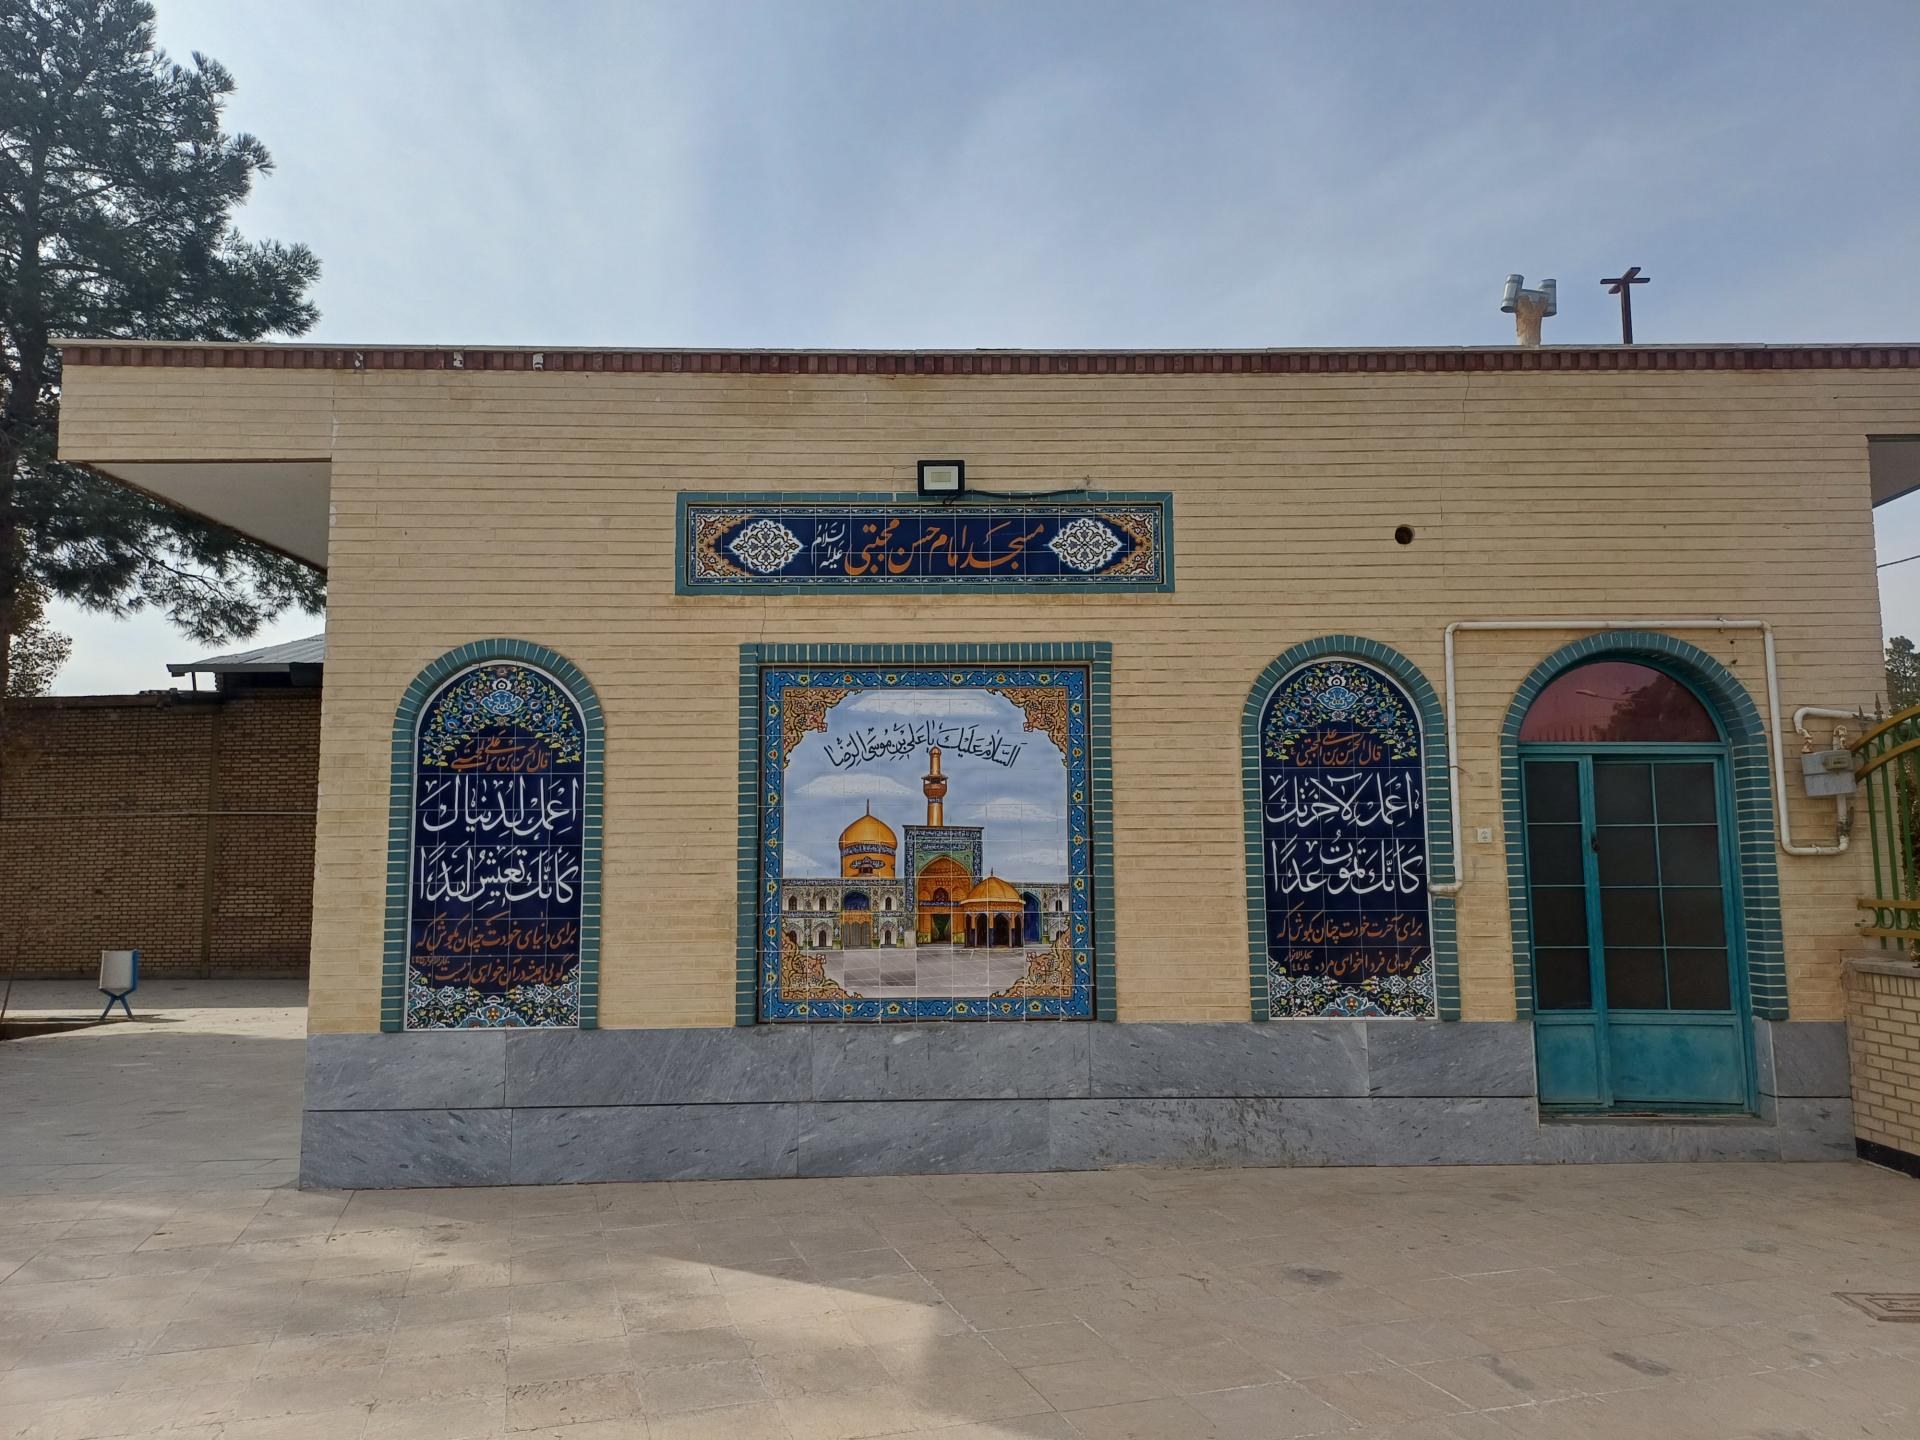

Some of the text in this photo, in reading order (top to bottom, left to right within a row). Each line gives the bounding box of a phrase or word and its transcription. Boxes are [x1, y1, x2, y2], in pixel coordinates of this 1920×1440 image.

[844, 519, 1045, 576] مسجد امام حسن مجتبی
[1396, 917, 1423, 942] برای
